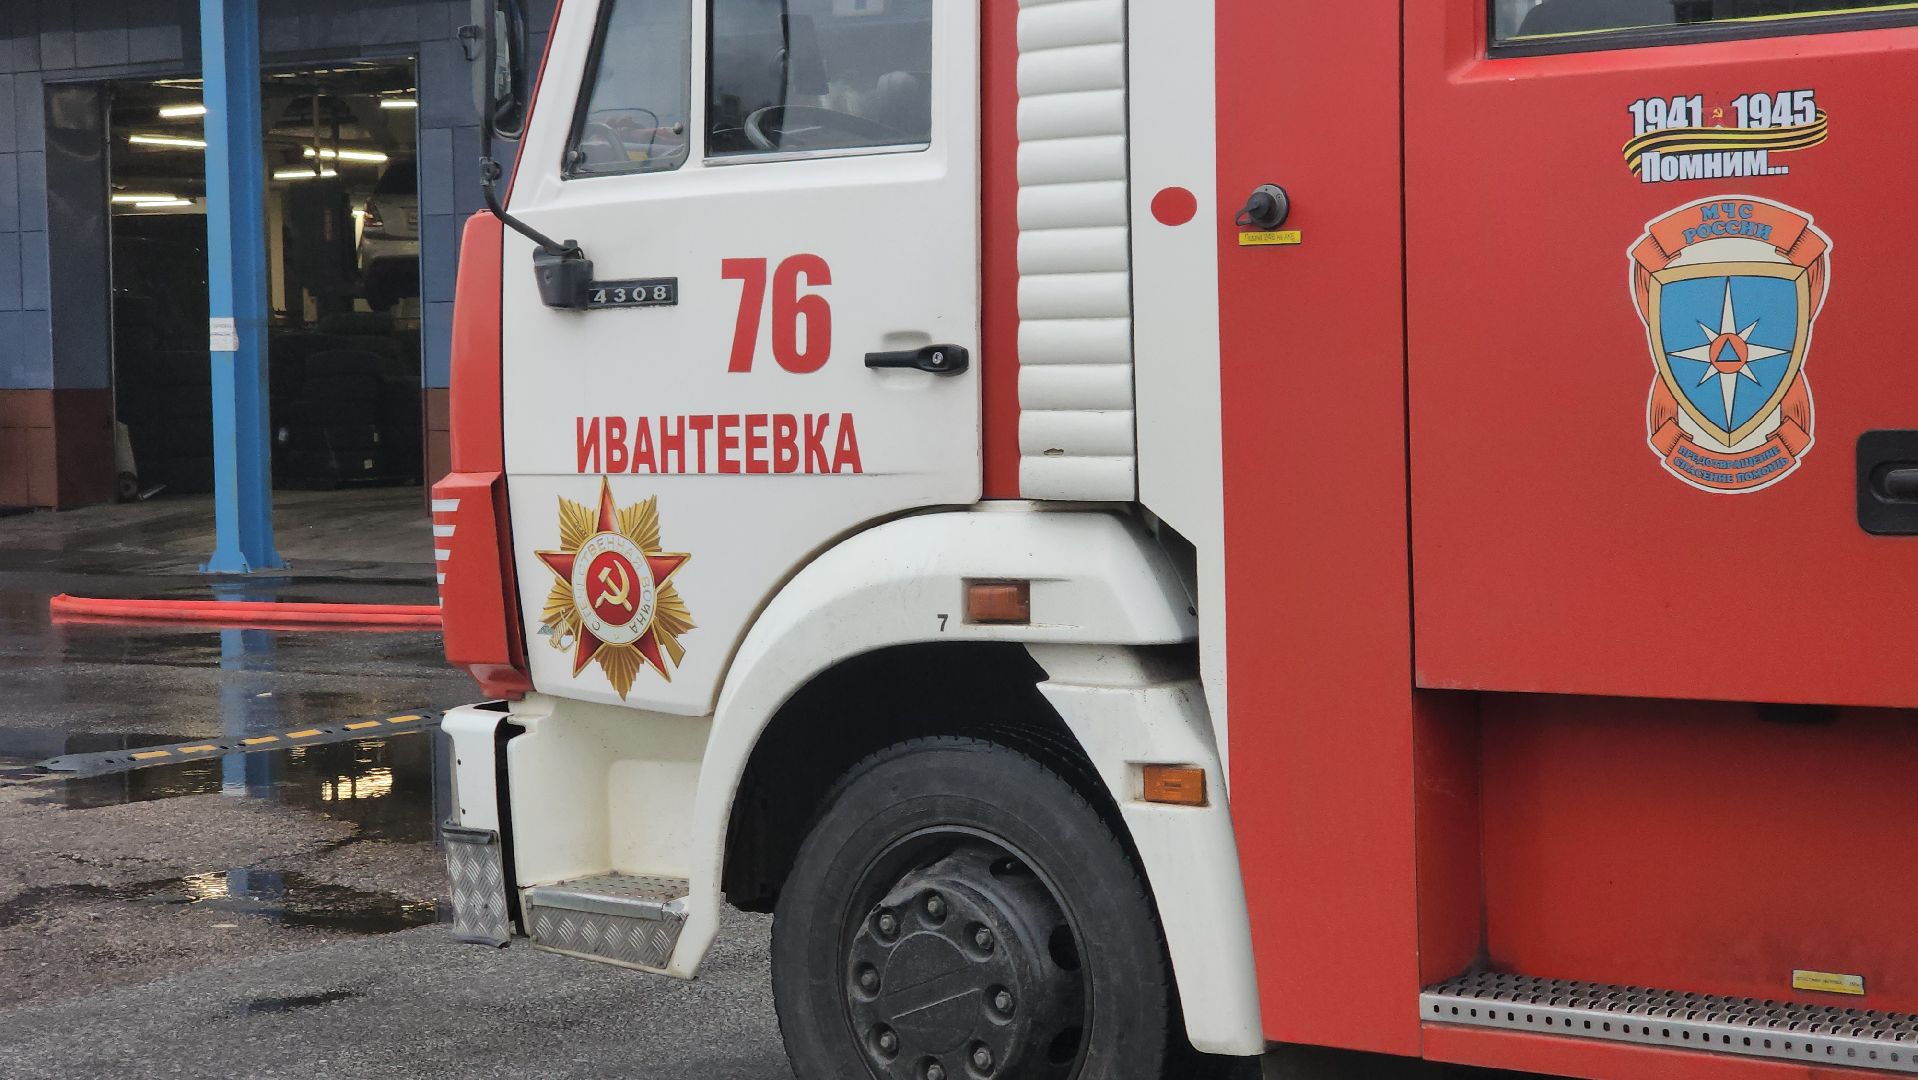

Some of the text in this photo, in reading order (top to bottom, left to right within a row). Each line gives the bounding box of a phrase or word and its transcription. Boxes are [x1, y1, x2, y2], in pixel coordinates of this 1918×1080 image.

[1627, 89, 1817, 137] 1941 1945
[1640, 149, 1790, 183] Помним...
[1700, 203, 1754, 221] МЧС
[1682, 220, 1773, 245] РОССИИ
[593, 286, 667, 303] 4308
[720, 253, 833, 375] 76
[576, 412, 864, 474] ИВАНТЕЕВКА
[1673, 456, 1789, 483] СПАСЕНИЕ ПОМОЩЬ
[1677, 445, 1781, 469] ПРЕДОТВРАЩЕНИЕ
[937, 613, 949, 631] 7
